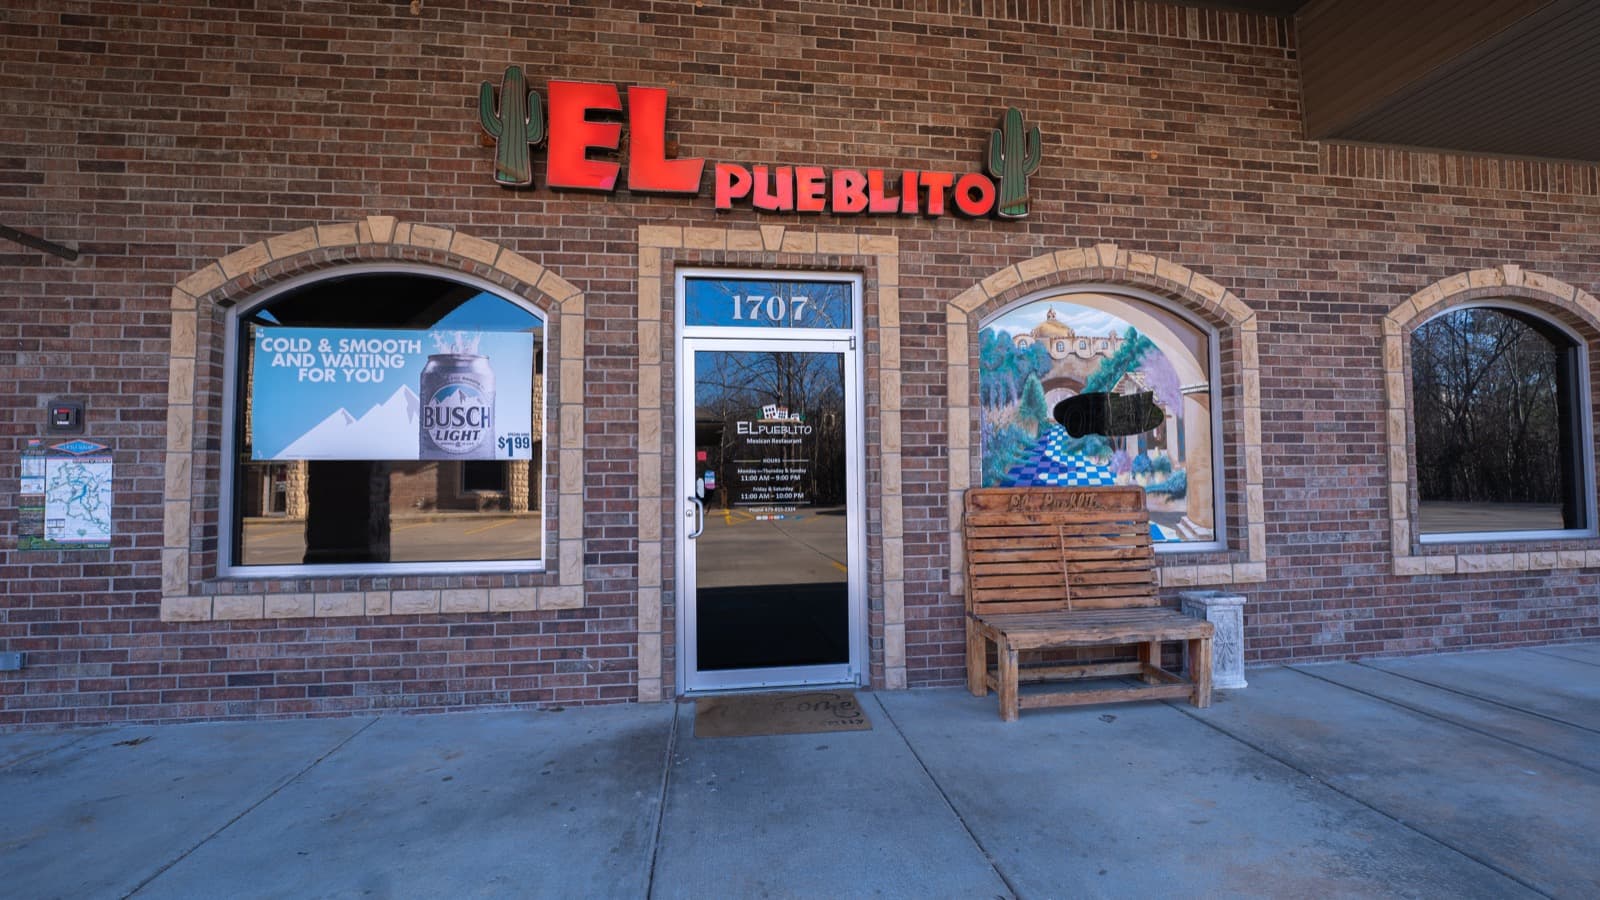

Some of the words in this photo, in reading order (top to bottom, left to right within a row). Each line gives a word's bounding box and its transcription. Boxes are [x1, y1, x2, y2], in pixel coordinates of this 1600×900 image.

[546, 80, 705, 195] EL
[714, 163, 997, 217] PUEBLITO
[733, 295, 809, 322] 1707
[261, 337, 312, 353] COLD
[318, 338, 332, 353] &
[339, 338, 422, 355] SMOOTH
[271, 353, 316, 368] AND
[321, 354, 406, 369] WAITING
[298, 368, 336, 383] FOR
[340, 369, 385, 384] YOU
[423, 405, 491, 429] BUSCH
[435, 430, 481, 442] LIGHT
[737, 421, 758, 435] EL
[758, 425, 812, 435] PUEBLITO
